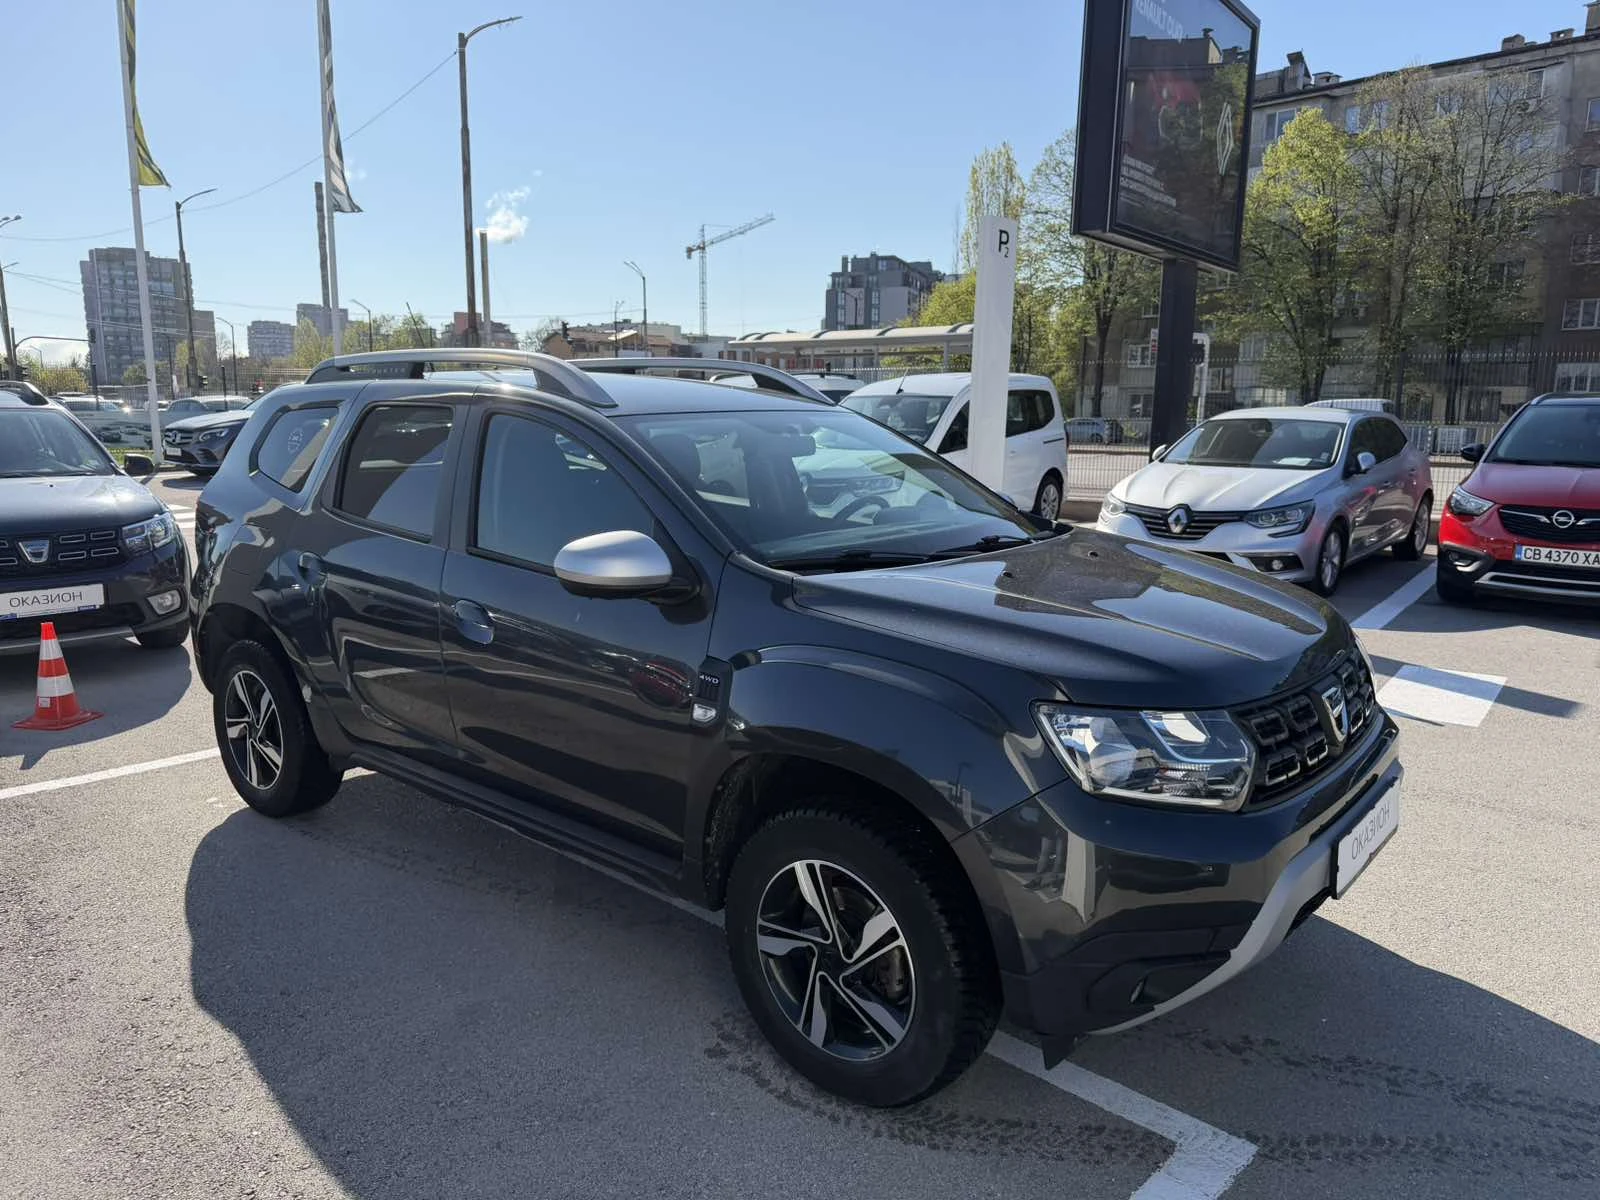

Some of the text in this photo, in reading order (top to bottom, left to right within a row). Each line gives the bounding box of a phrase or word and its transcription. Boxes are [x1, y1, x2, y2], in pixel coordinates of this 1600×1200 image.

[1523, 548, 1542, 561] CB
[1544, 550, 1580, 564] 4370
[9, 591, 83, 608] ОКАЗИОН
[699, 674, 719, 684] 4WD
[1351, 801, 1390, 860] ОКАЗИОН
